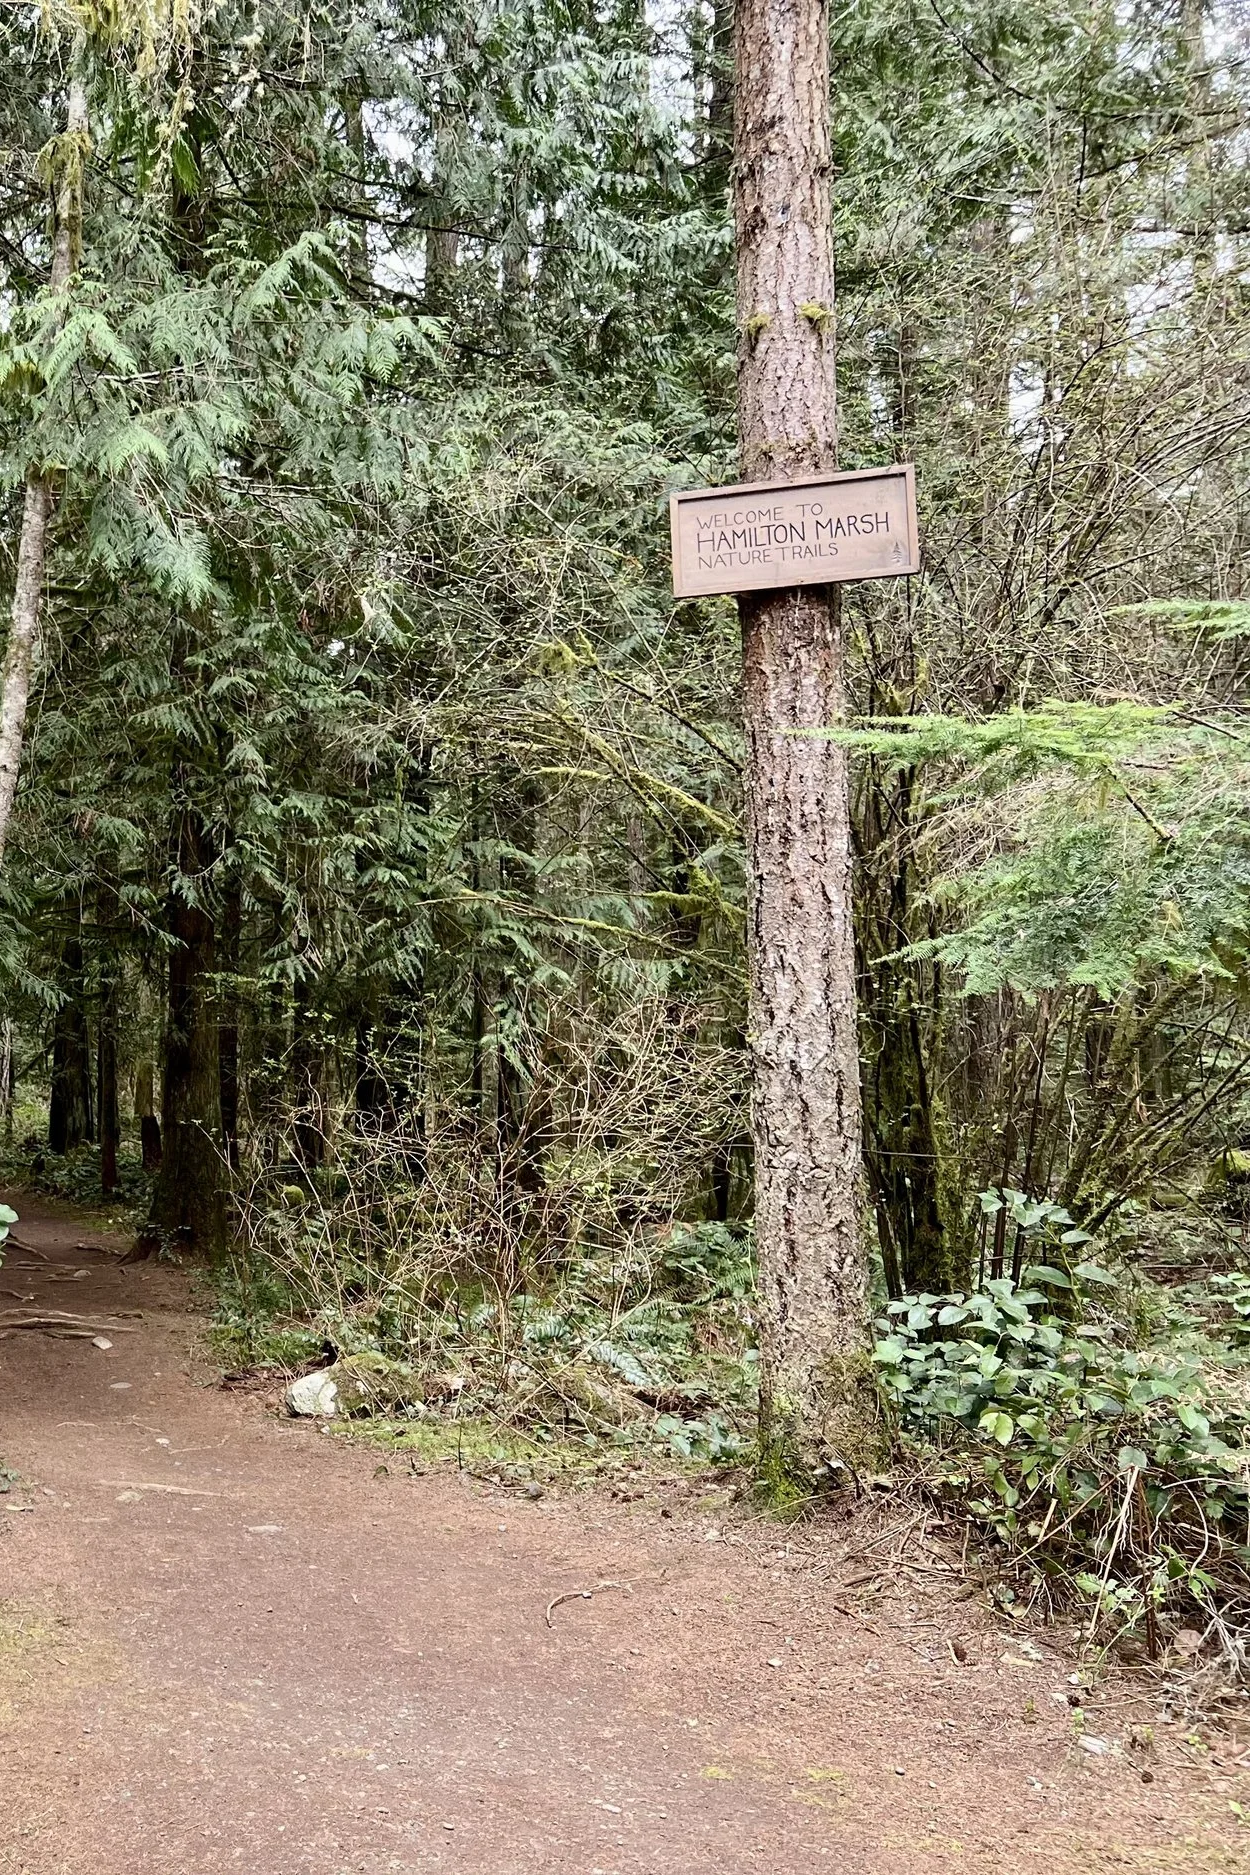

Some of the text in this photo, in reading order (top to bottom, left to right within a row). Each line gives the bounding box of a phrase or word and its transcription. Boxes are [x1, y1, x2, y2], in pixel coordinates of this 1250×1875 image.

[696, 502, 823, 530] WELCOME TO
[697, 511, 890, 553] HAMILTON MARSH
[698, 542, 838, 570] NATURE TRAILS
